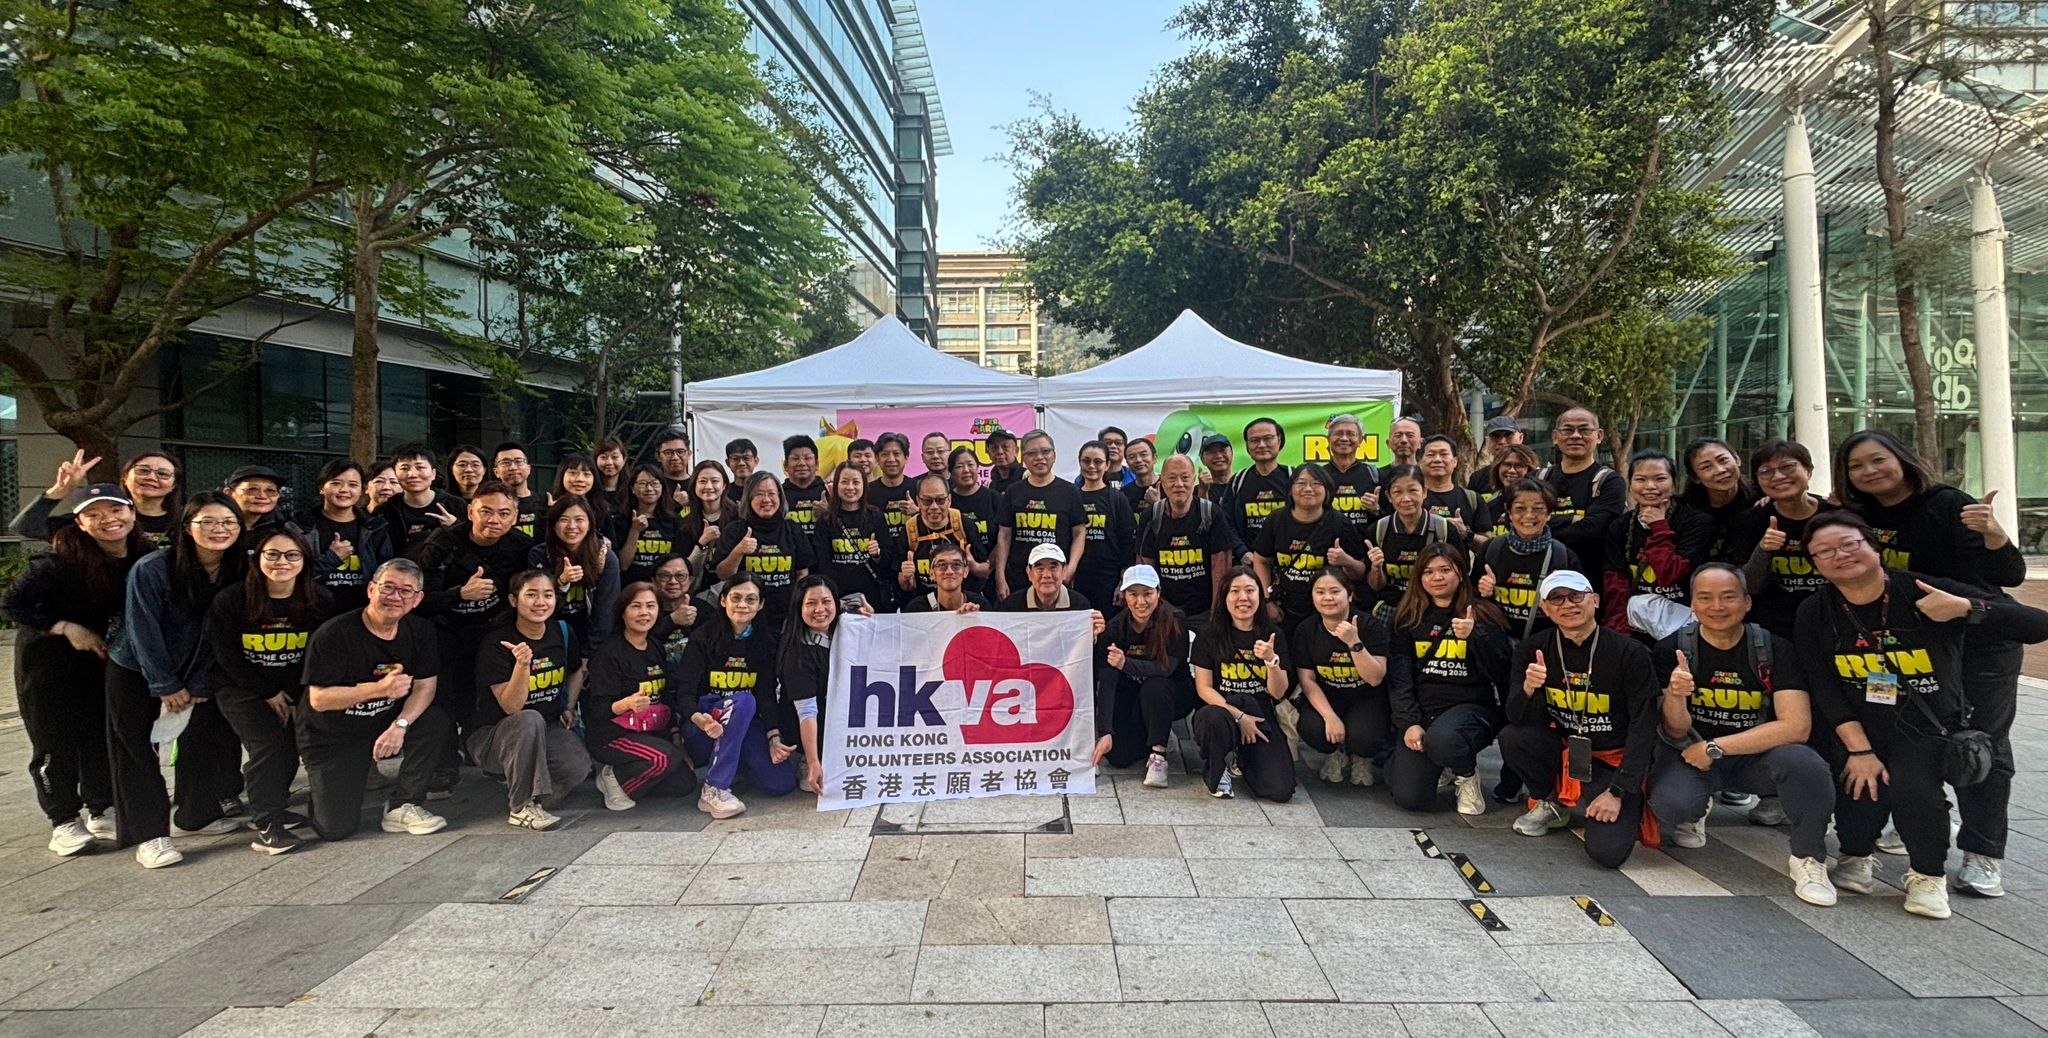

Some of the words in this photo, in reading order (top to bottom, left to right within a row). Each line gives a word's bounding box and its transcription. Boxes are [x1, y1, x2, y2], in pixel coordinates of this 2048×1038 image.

[974, 418, 999, 426] SUPER
[1303, 434, 1379, 462] RN
[1014, 512, 1058, 530] RUN
[1023, 530, 1035, 538] THE
[1036, 530, 1057, 539] GOAL
[636, 539, 672, 554] RUN
[745, 555, 792, 573] RUN
[1158, 548, 1204, 566] RUN
[1276, 552, 1325, 571] RUN
[1160, 566, 1169, 574] TO
[1170, 567, 1184, 575] THE
[1185, 565, 1205, 574] GOAL
[1386, 563, 1415, 579] RU
[1771, 556, 1820, 575] RU
[1783, 578, 1804, 586] THE
[242, 631, 309, 652] RUN
[1220, 662, 1269, 680] RUN
[1427, 660, 1439, 668] HE
[1440, 660, 1467, 671] GOAL
[1834, 648, 1934, 679] RUN
[528, 666, 565, 691] RUN
[1430, 666, 1448, 676] Kong
[1448, 668, 1468, 677] 2026
[709, 671, 758, 689] RUN
[1221, 678, 1231, 687] TO
[1232, 681, 1247, 689] THE
[1909, 676, 1938, 687] OAL
[531, 690, 546, 699] THE
[847, 665, 1038, 728] hkva
[1916, 684, 1940, 694] 026
[367, 699, 386, 710] THE
[1545, 686, 1610, 714] RUN
[1690, 687, 1763, 711] RUN
[1581, 716, 1613, 725] GOAL
[1696, 714, 1718, 726] Hong
[1718, 719, 1741, 729] Kong
[1707, 710, 1730, 720] THE
[1732, 713, 1758, 721] GOA
[1590, 725, 1613, 733] 2026
[846, 734, 895, 748] HONG
[900, 733, 948, 747] KONG
[844, 752, 956, 767] VOLUNTEERS
[961, 748, 1071, 765] ASSOCIATION
[841, 768, 1072, 801] 香港志願者協會
